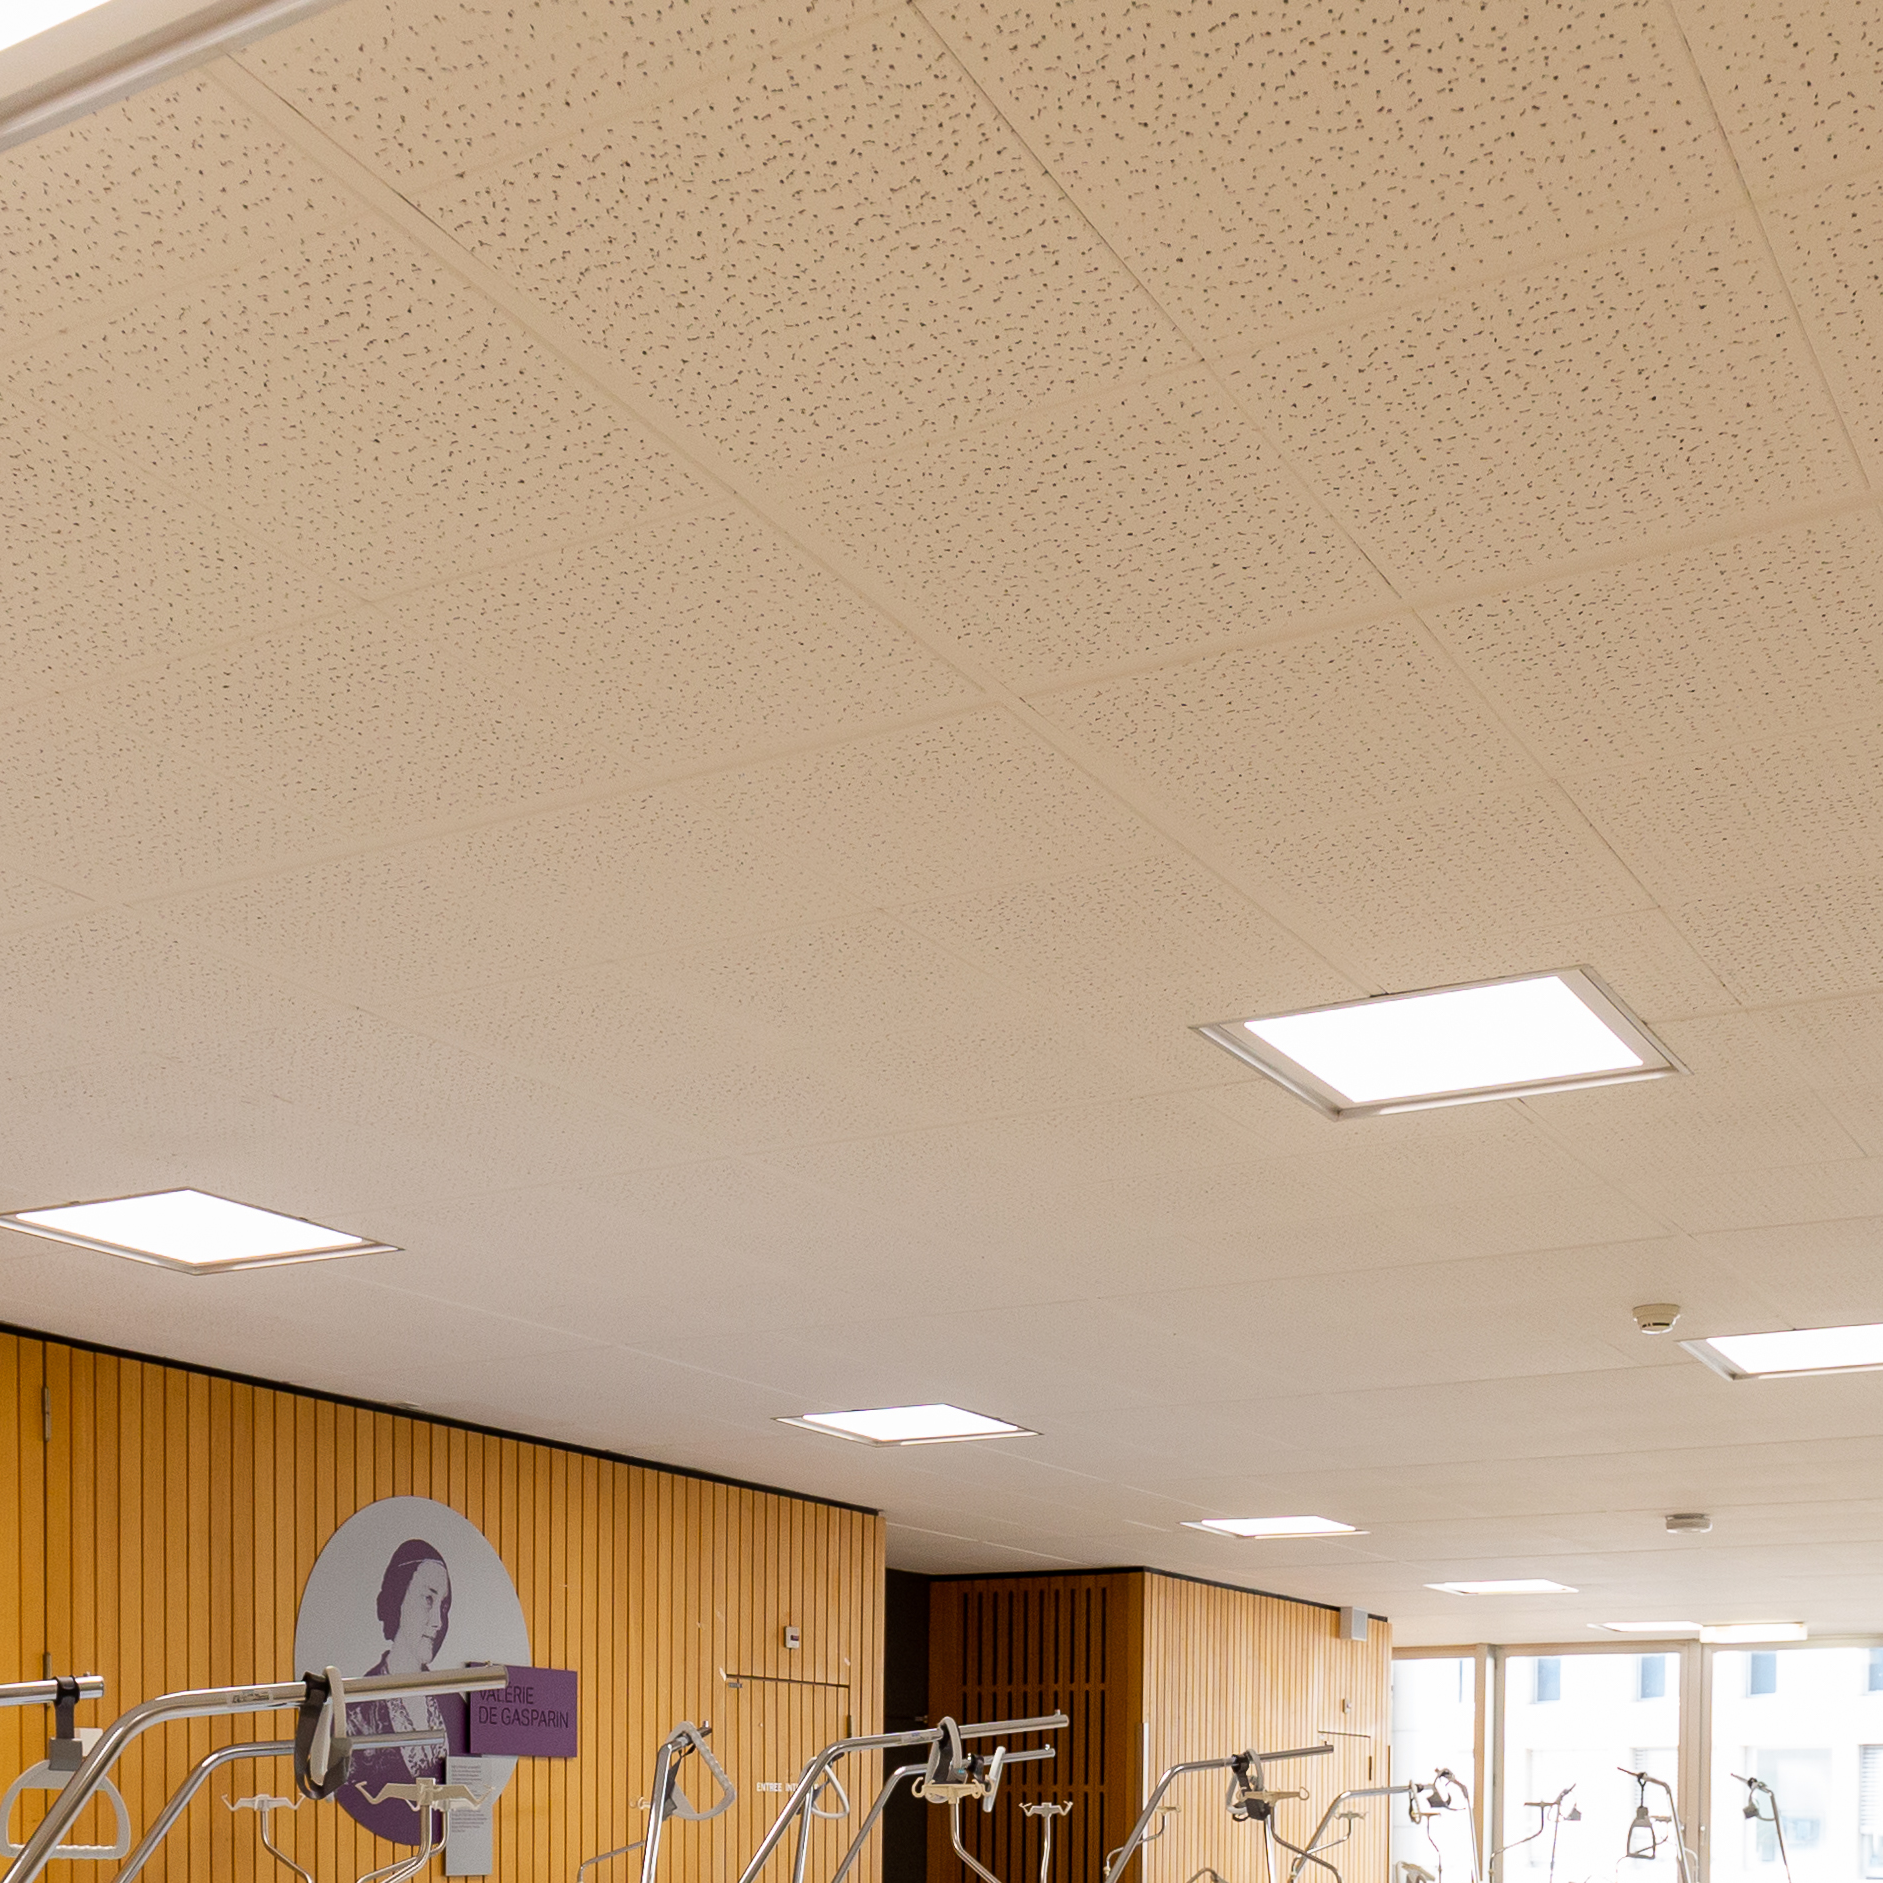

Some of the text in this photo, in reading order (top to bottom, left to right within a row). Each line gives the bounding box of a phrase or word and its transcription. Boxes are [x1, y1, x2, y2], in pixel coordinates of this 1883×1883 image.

[480, 1682, 534, 1704] VALÉRIE
[478, 1706, 569, 1728] DE GASPARIN
